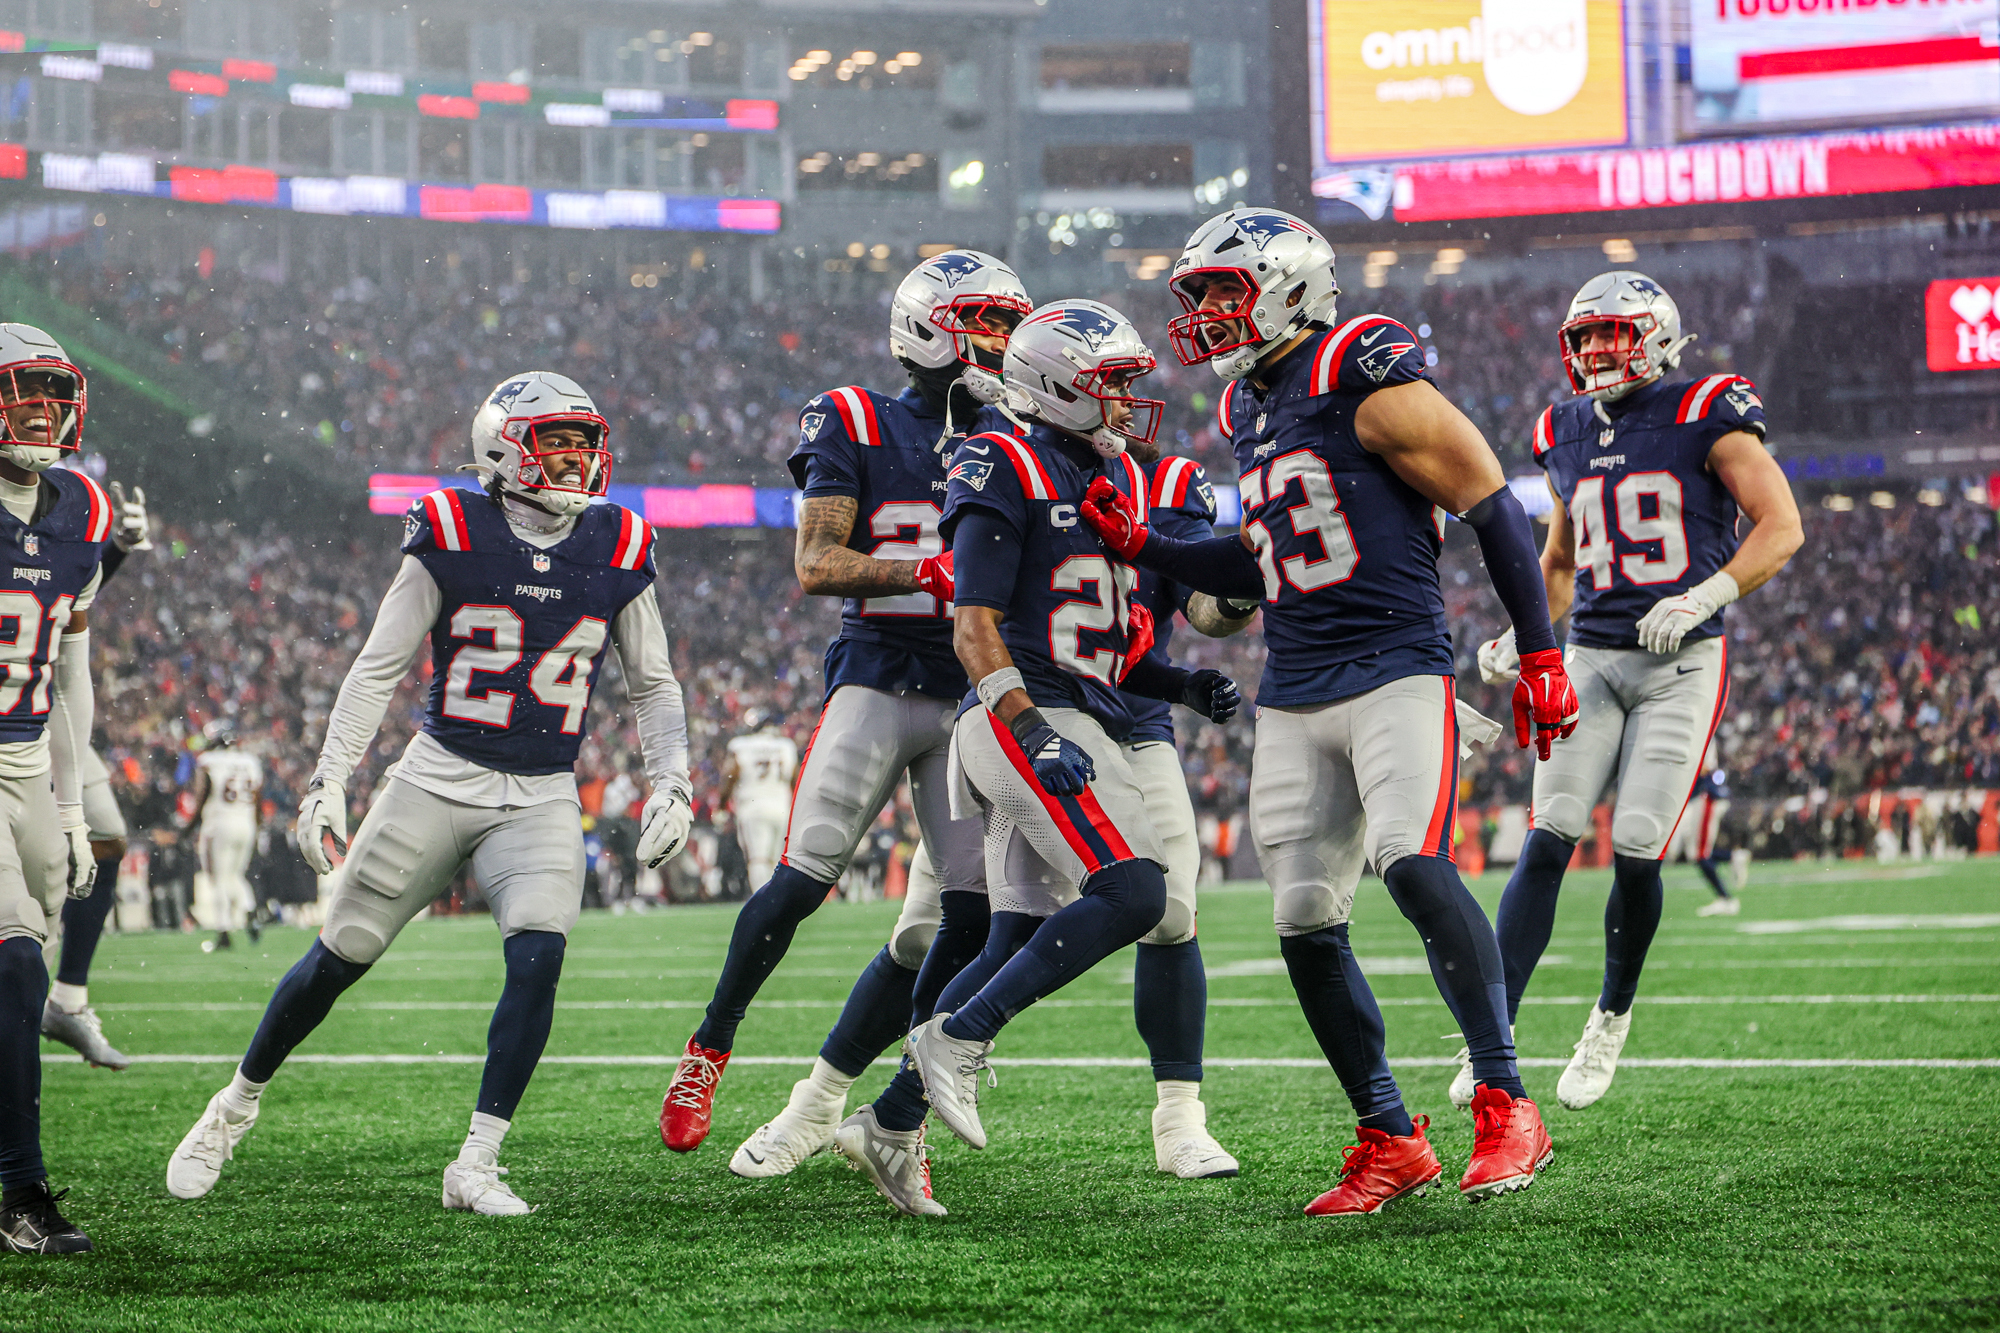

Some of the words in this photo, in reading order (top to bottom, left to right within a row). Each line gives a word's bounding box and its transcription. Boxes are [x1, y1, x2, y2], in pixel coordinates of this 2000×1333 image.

[1600, 139, 1828, 207] TOUCHDOWN
[1590, 454, 1626, 470] PATRIOTS
[1050, 504, 1078, 528] C
[1239, 448, 1361, 603] 53
[1570, 470, 1690, 591] 49
[13, 567, 51, 581] PATRIOTS
[515, 584, 562, 600] PATRIOTS
[861, 501, 954, 619] 2
[442, 603, 608, 735] 24
